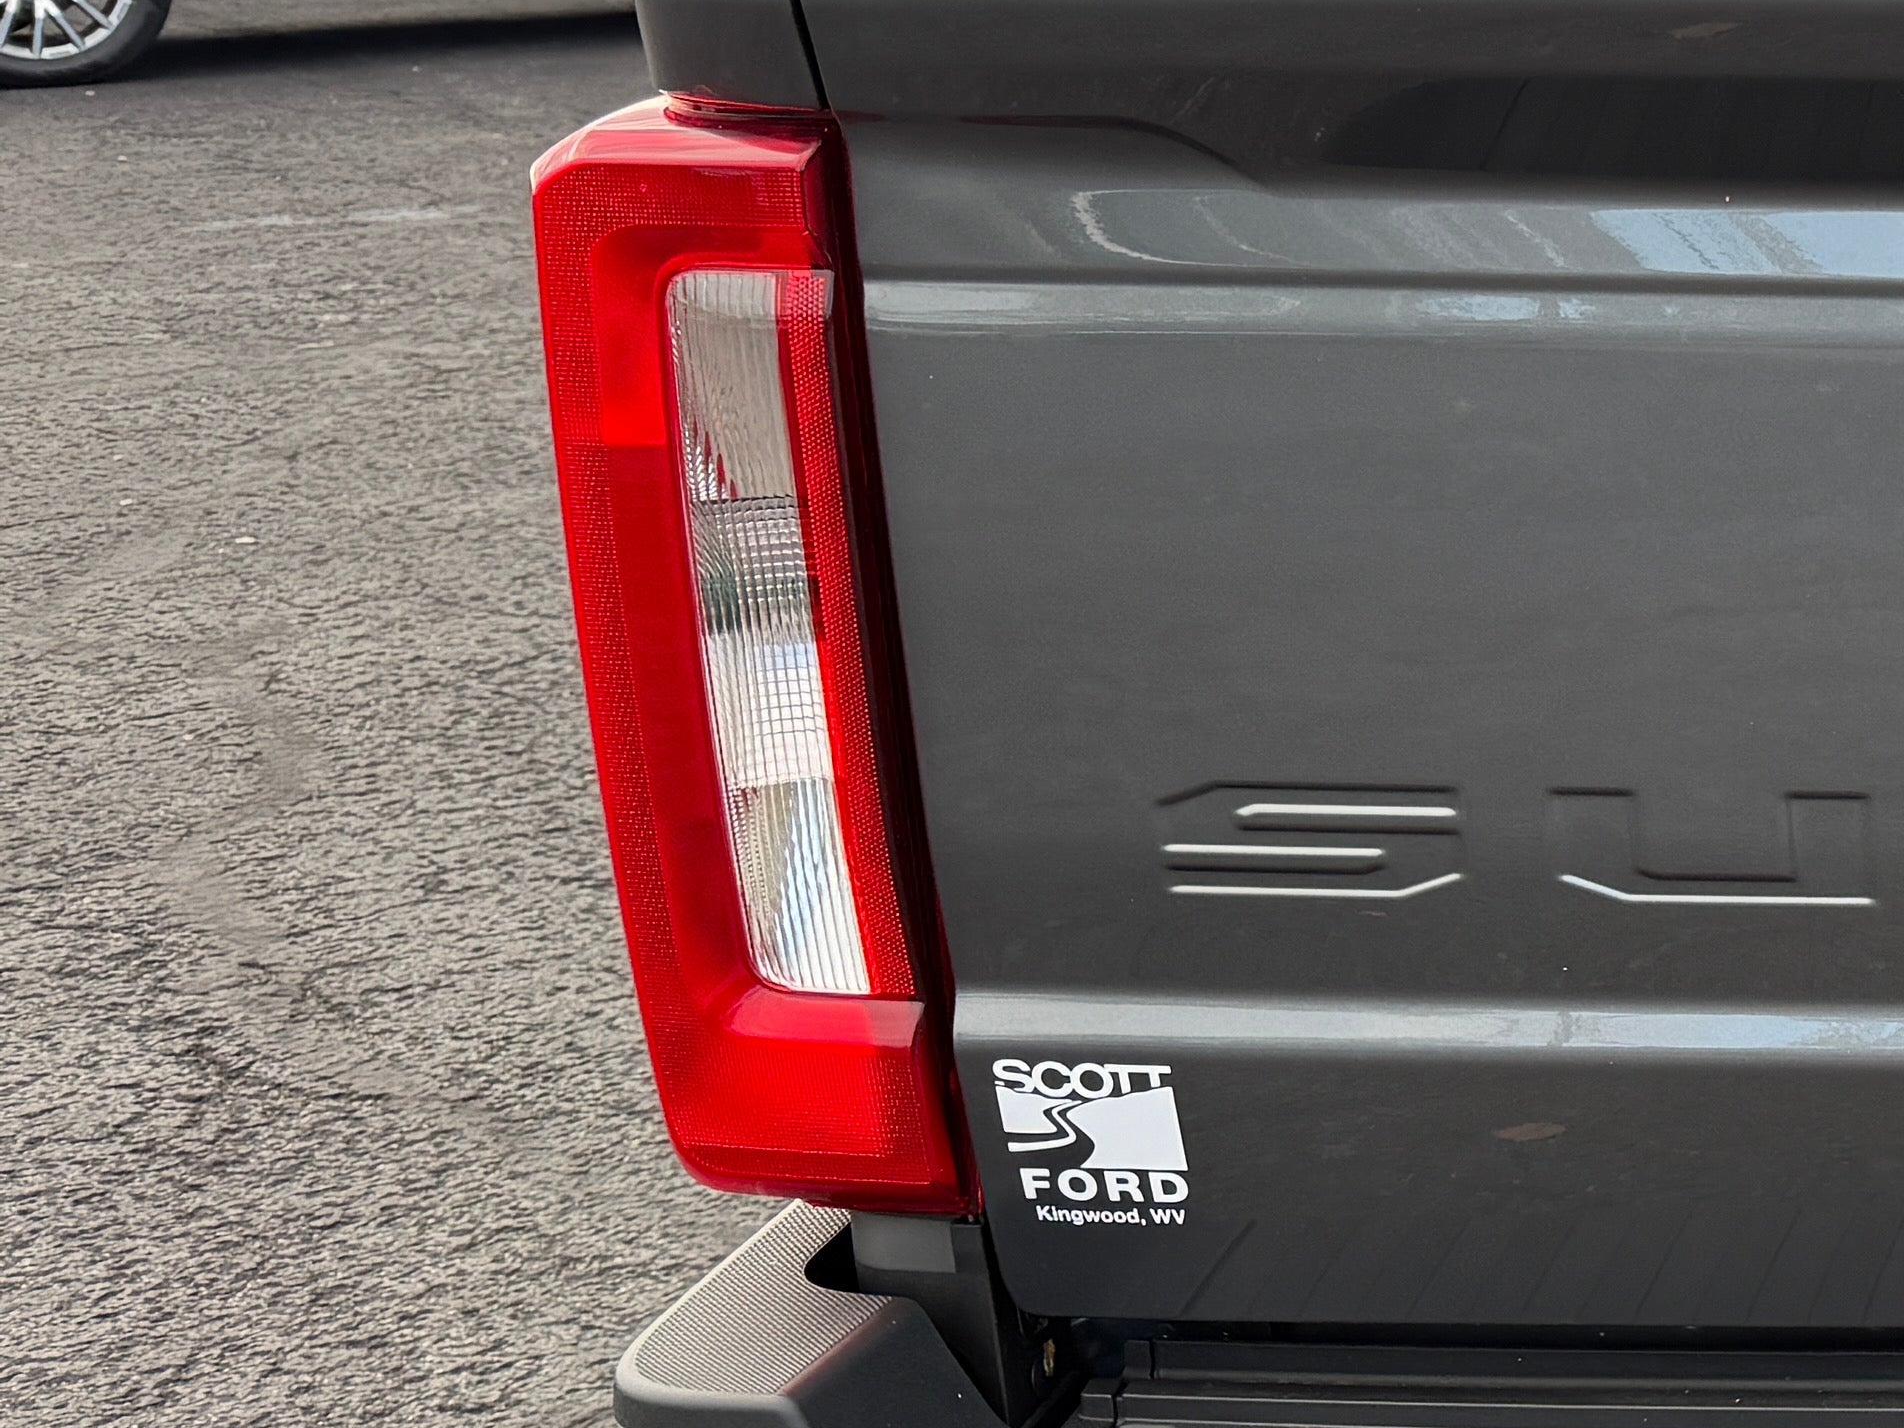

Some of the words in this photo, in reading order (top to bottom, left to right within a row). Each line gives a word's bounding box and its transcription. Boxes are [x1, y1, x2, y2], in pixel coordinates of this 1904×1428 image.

[991, 1058, 1172, 1100] SCOTT
[1019, 1167, 1189, 1204] FORD
[1035, 1204, 1147, 1227] Kingwood,
[1149, 1207, 1186, 1225] WV
